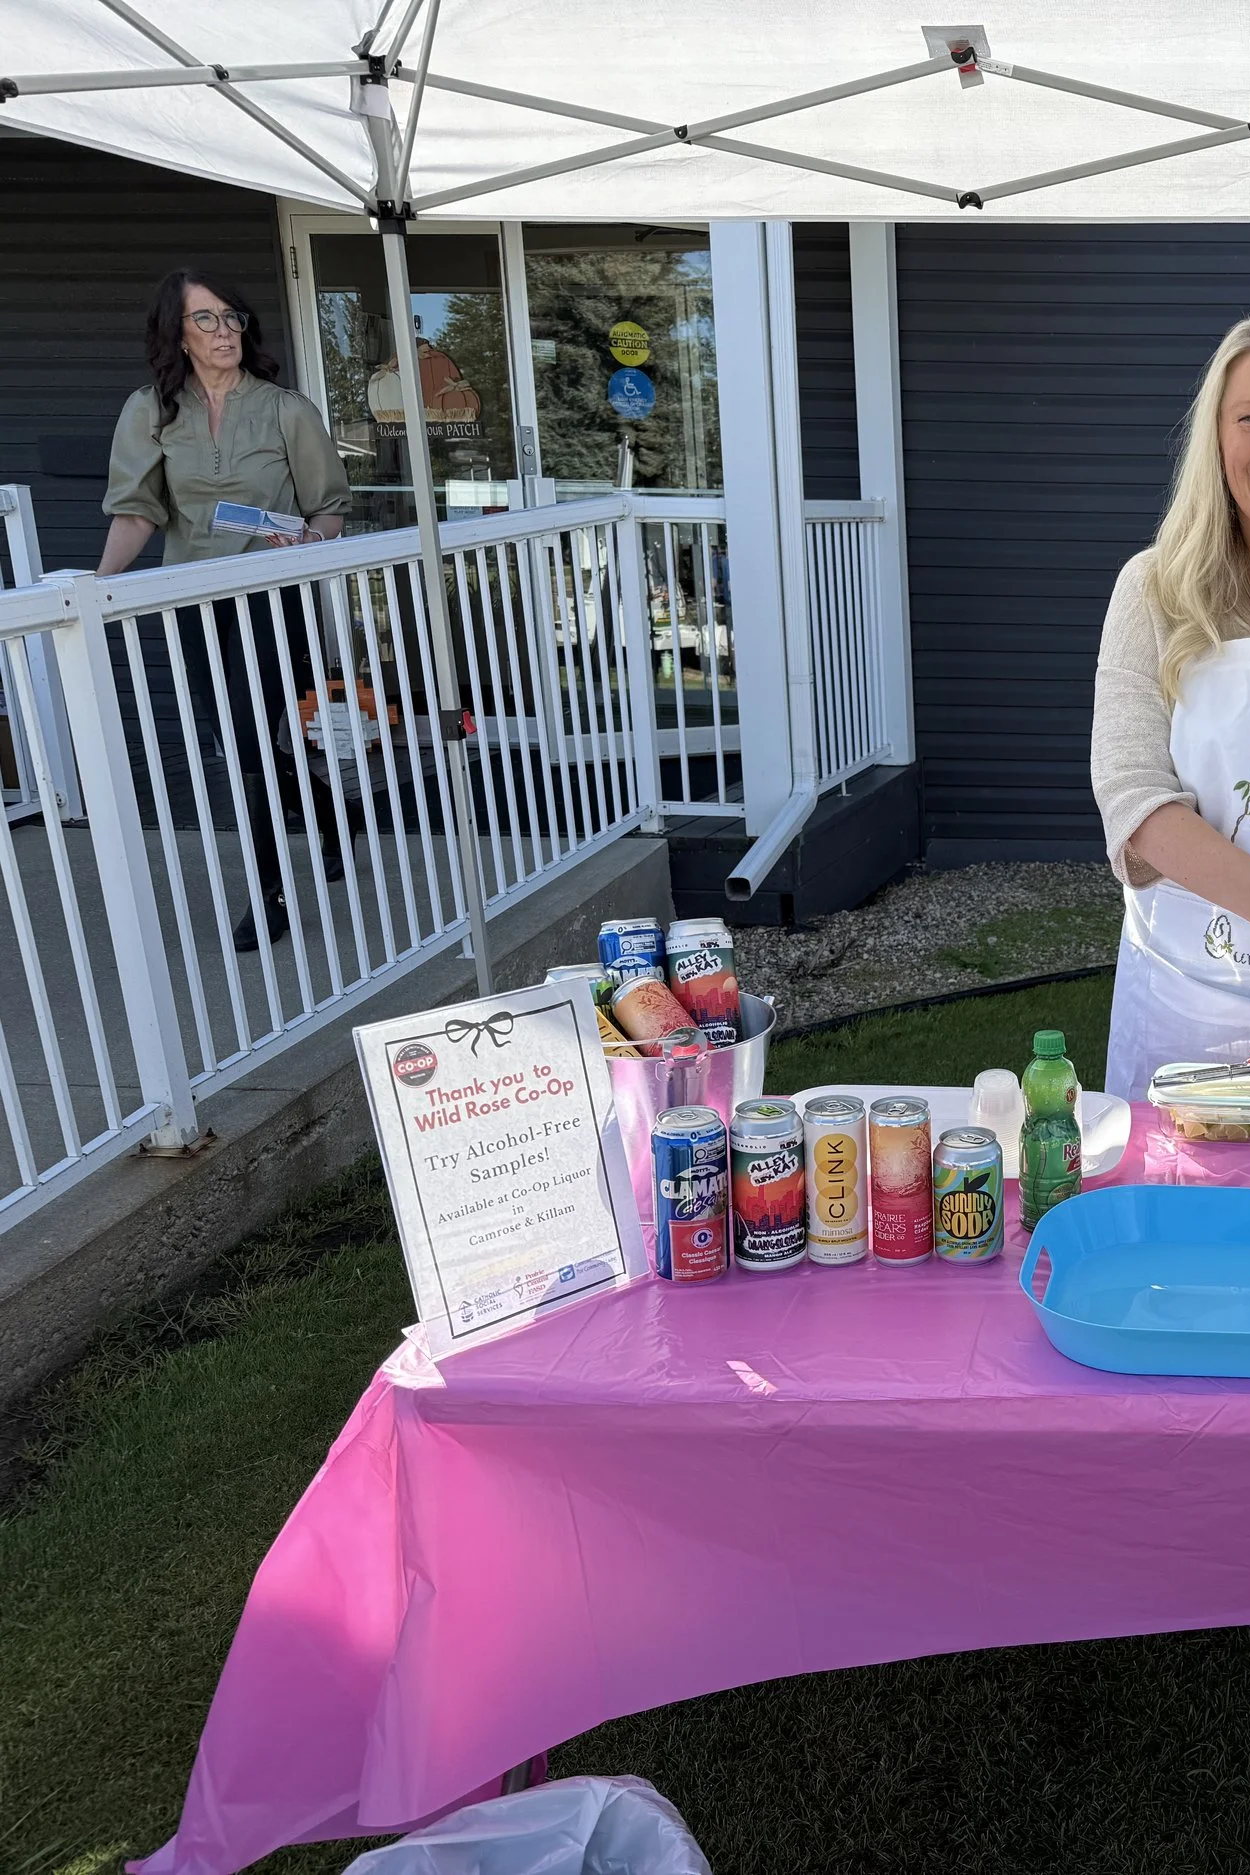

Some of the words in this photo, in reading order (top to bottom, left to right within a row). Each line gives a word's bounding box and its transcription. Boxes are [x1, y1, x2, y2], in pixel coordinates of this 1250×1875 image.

[611, 339, 647, 348] CAUTION
[377, 424, 406, 436] Welco
[446, 424, 479, 436] PATCH
[678, 953, 706, 971] ALLEY
[695, 958, 718, 972] KAT
[425, 1078, 486, 1107] Thank
[491, 1072, 524, 1094] you
[533, 1064, 552, 1078] to
[414, 1105, 461, 1133] Wild
[467, 1098, 511, 1119] Rose
[515, 1078, 574, 1105] Co-Op
[425, 1152, 460, 1172] Try
[467, 1116, 581, 1161] Alcohol-Free
[470, 1148, 550, 1184] Samples!
[750, 1154, 786, 1172] ALLEY
[773, 1157, 796, 1176] KAT
[660, 1170, 728, 1200] CLAMAT
[827, 1140, 845, 1219] CLINK
[438, 1198, 494, 1225] Available
[498, 1193, 509, 1205] at
[512, 1182, 550, 1201] Co-Op
[553, 1168, 592, 1188] Liquor
[942, 1192, 992, 1212] SUNNY
[512, 1204, 524, 1216] in
[875, 1210, 906, 1222] PRAIRIE
[469, 1225, 522, 1247] Camrose
[525, 1217, 533, 1227] &
[536, 1204, 575, 1223] Killam
[874, 1219, 906, 1233] BEARS
[942, 1210, 993, 1237] SODA
[822, 1228, 853, 1236] mimosa
[875, 1230, 896, 1241] CIDER
[689, 1256, 716, 1264] Classique
[525, 1269, 545, 1280] Prairie
[474, 1289, 500, 1302] CATHOLIC
[528, 1284, 546, 1295] FASD
[476, 1299, 496, 1309] SOCIAL
[477, 1303, 502, 1316] SERVICES
